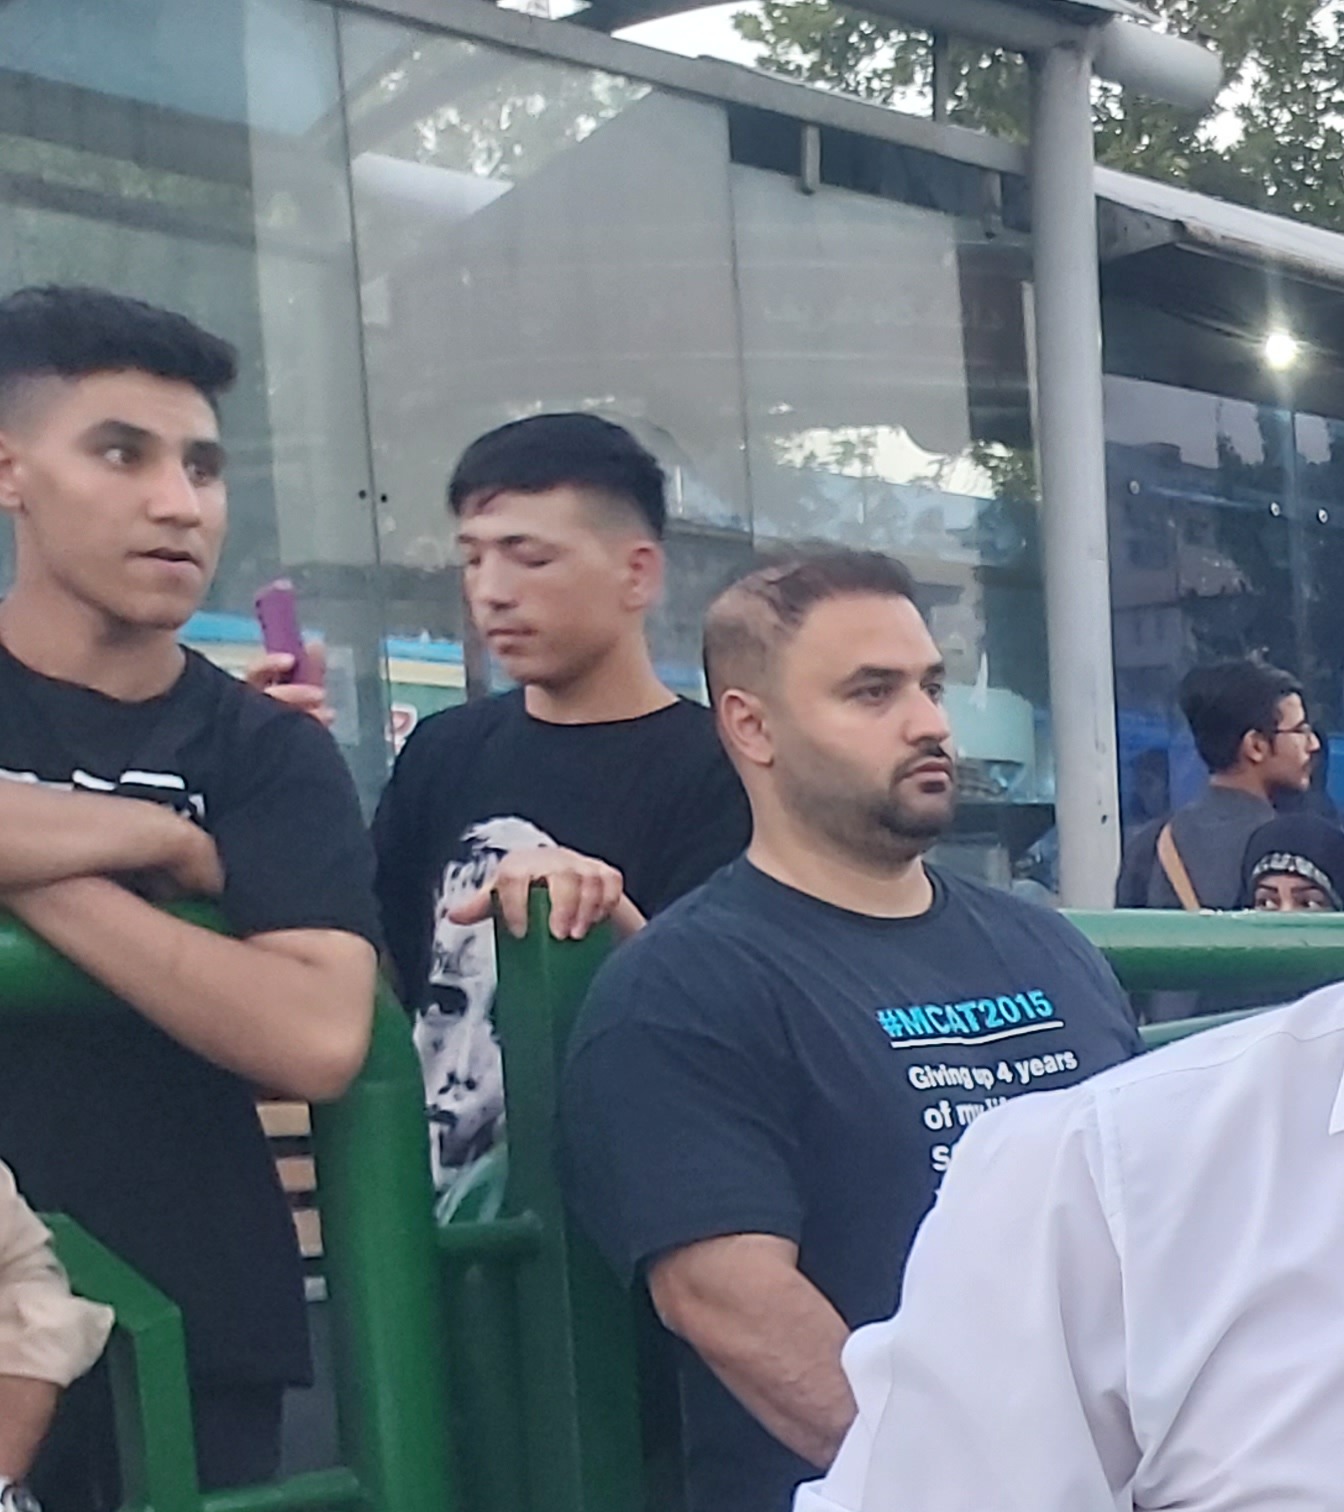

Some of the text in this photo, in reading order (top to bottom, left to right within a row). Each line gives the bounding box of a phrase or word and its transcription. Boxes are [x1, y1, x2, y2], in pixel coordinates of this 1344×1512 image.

[877, 989, 1054, 1038] #MCAT2015
[908, 1050, 1078, 1091] Giving up 4 years
[923, 1099, 953, 1130] of
